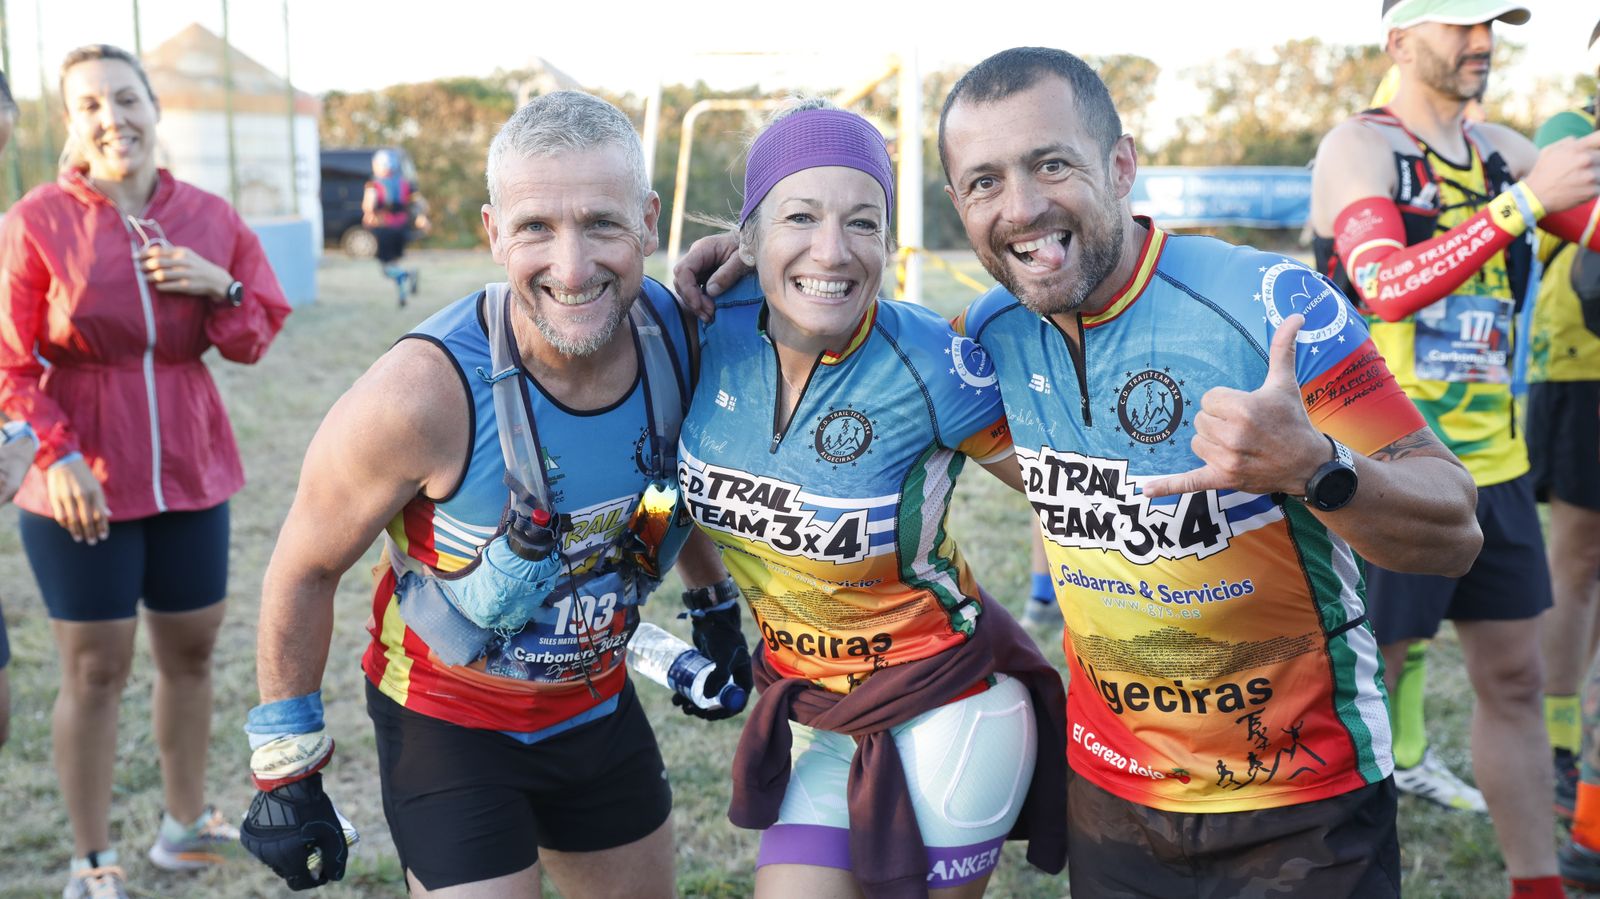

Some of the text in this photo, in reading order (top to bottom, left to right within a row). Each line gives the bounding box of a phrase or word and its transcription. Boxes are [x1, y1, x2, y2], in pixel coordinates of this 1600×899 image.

[1379, 226, 1496, 301] ALGECIRAS
[1379, 259, 1415, 282] CLUB
[1149, 371, 1170, 385] TEAM
[830, 411, 849, 419] TRAIL
[1131, 429, 1171, 443] ALGECIRAS
[820, 451, 855, 463] ALGECIRAS
[678, 467, 794, 514] C.D. TRAIL
[1044, 455, 1126, 502] TRAIL
[564, 506, 625, 550] RAIL
[687, 499, 770, 538] TEAM
[771, 514, 862, 559] 3x4
[1030, 489, 1221, 556] TEAM 3x4
[1061, 563, 1255, 605] Gabarras & Servicios
[553, 592, 617, 636] 193
[1102, 596, 1201, 619] www.gys.es
[513, 647, 598, 664] Carbonera
[599, 633, 628, 654] 2023
[539, 637, 557, 646] SILES
[1072, 723, 1082, 744] El
[1084, 731, 1128, 770] Cerezo
